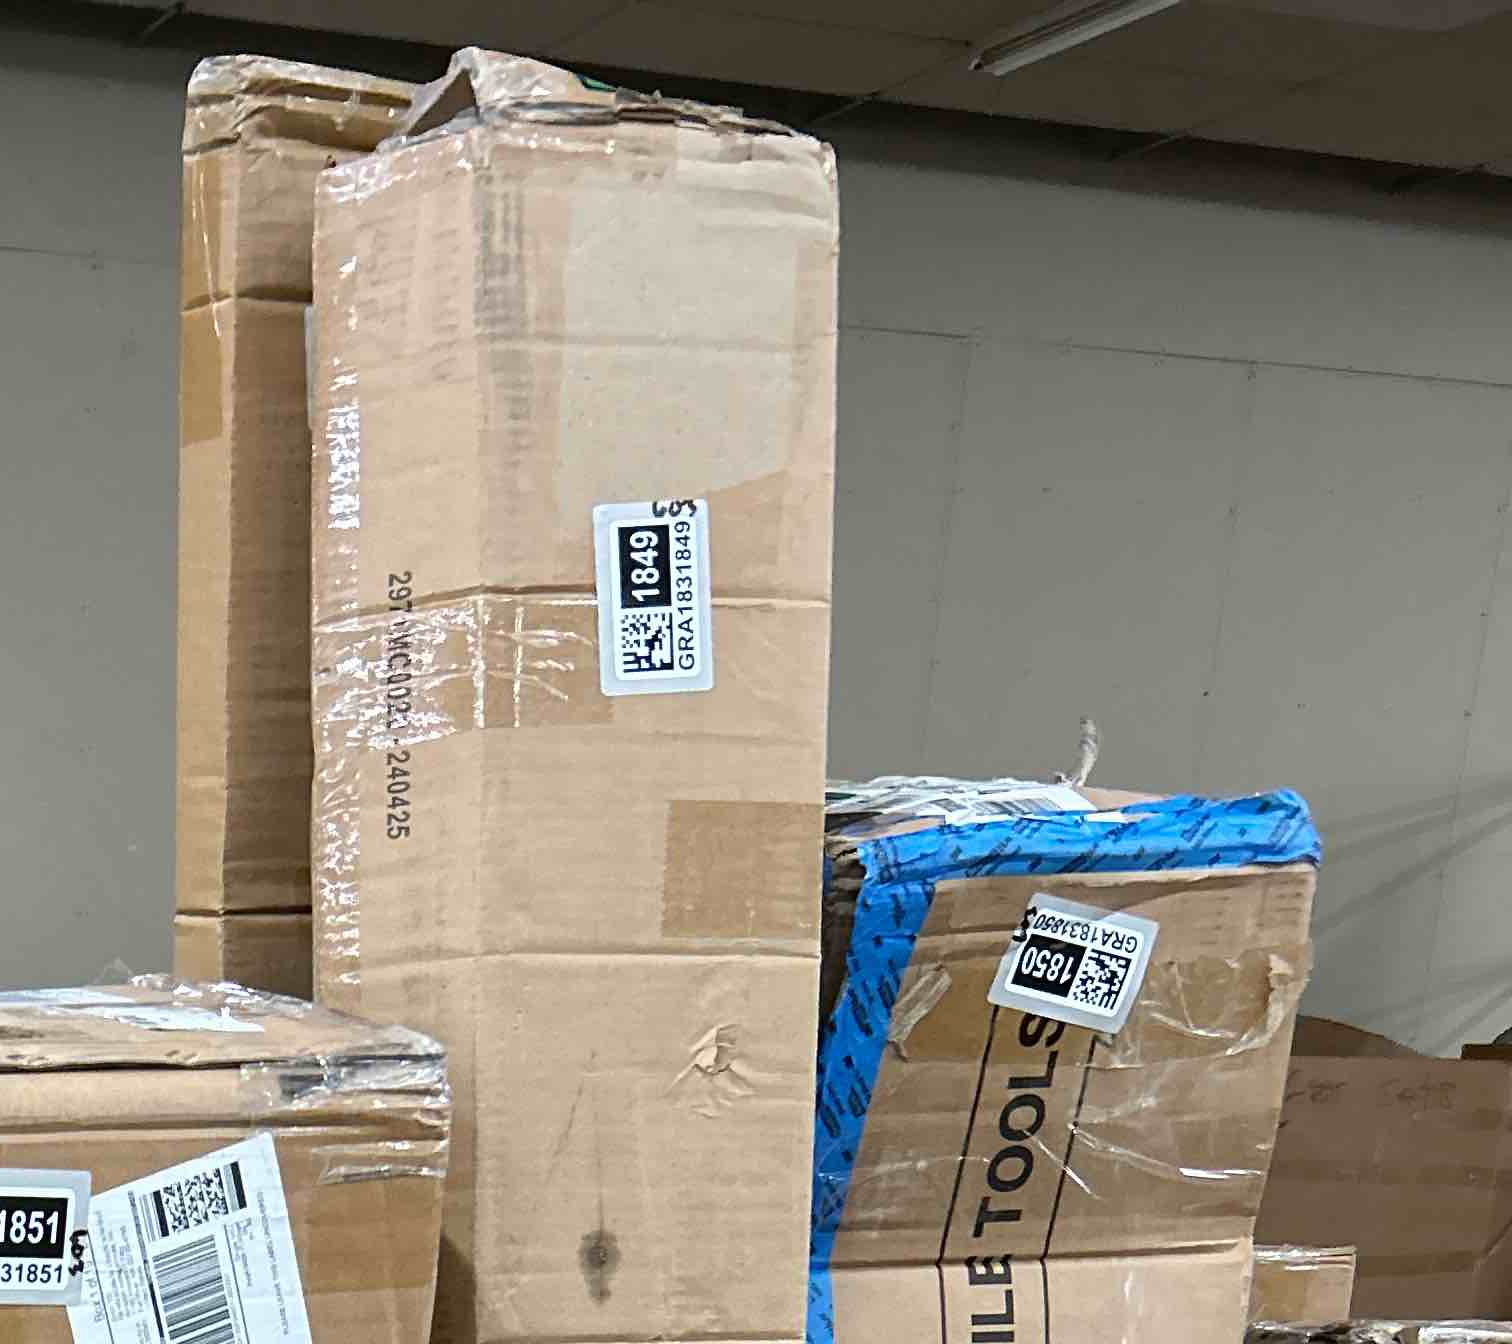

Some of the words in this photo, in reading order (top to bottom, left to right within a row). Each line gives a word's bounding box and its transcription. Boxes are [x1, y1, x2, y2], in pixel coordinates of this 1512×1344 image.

[630, 530, 660, 602] 1849
[674, 521, 695, 670] GRA1831849
[1021, 946, 1075, 985] 1850
[1033, 914, 1138, 954] GRA1831850
[973, 1012, 1065, 1238] TOOLS
